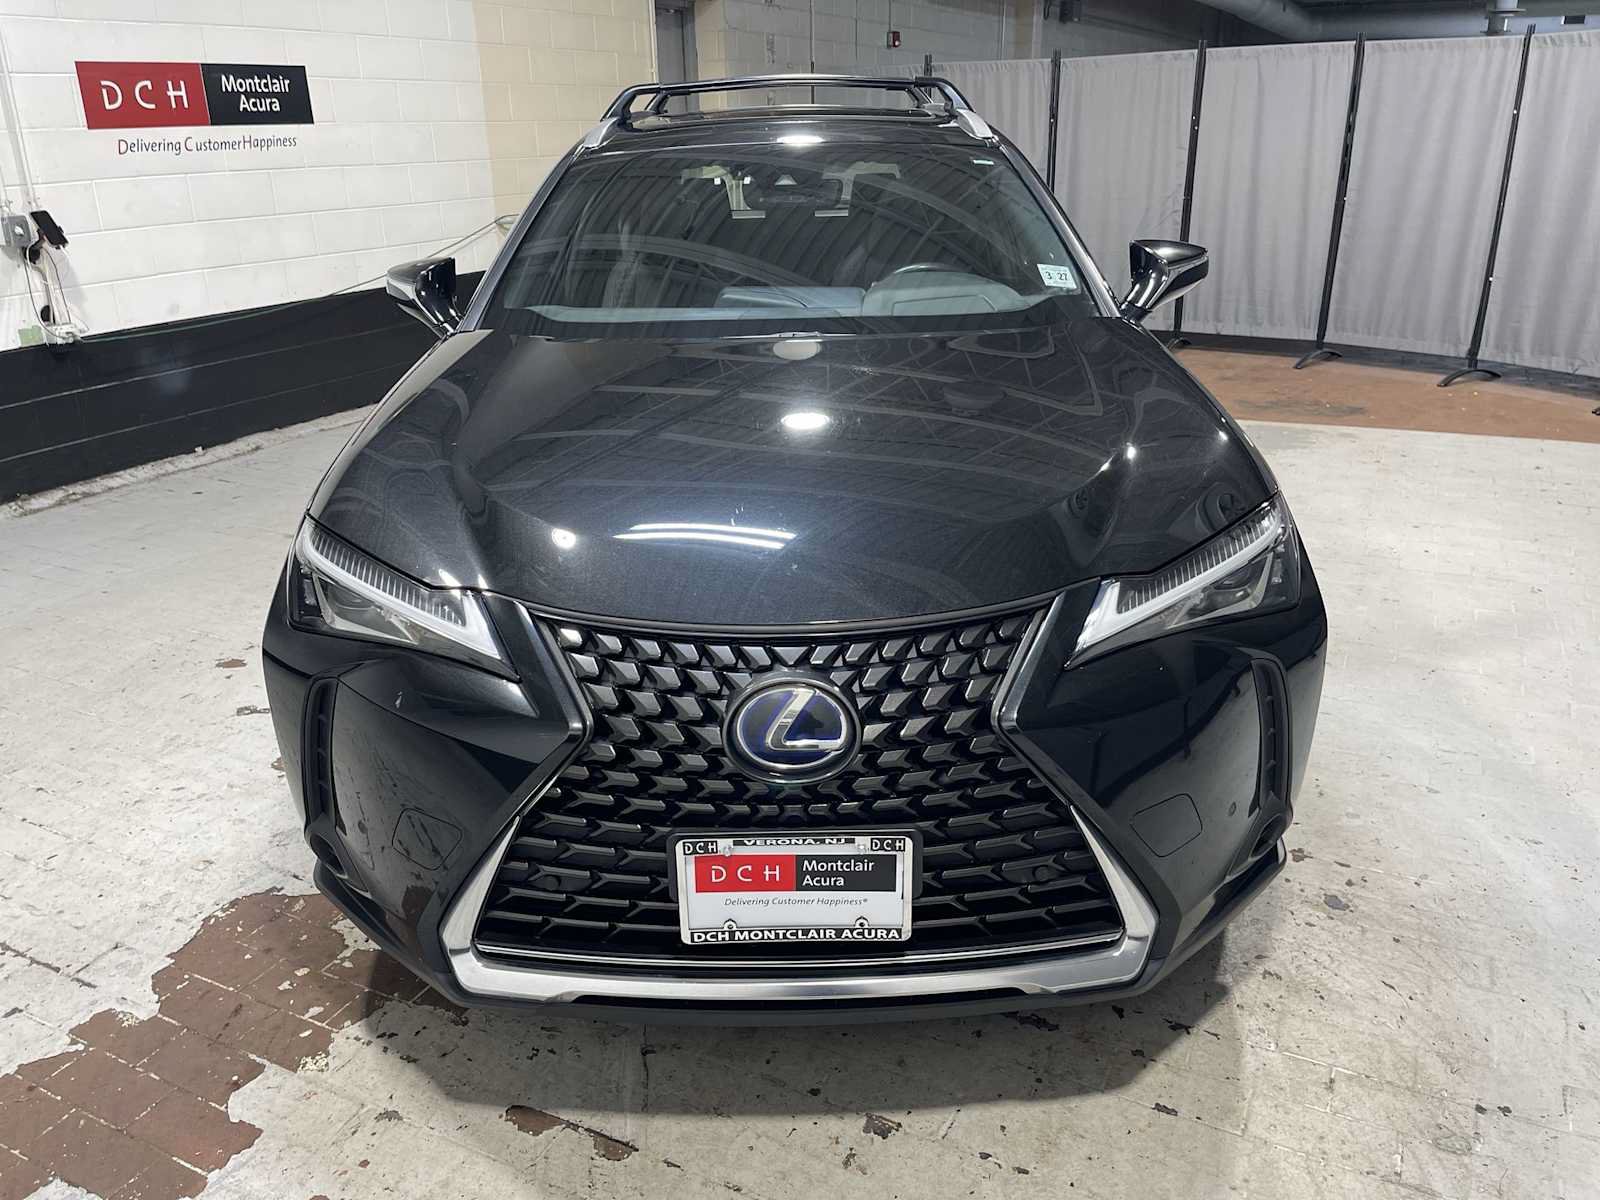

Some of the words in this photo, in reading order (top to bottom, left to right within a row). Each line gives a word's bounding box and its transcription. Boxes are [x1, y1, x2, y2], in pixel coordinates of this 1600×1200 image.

[220, 74, 290, 94] Montclair
[239, 95, 281, 112] Acura
[117, 139, 182, 156] Delivering
[684, 842, 718, 855] DCH
[871, 839, 905, 851] DCH
[802, 859, 875, 873] Montclair
[711, 865, 780, 883] DCH
[802, 875, 845, 887] Acura
[724, 897, 770, 907] Delivering
[771, 896, 815, 905] Customer
[693, 931, 730, 943] DCH
[734, 928, 839, 942] MONTCLAIR
[841, 927, 900, 940] ACURA
